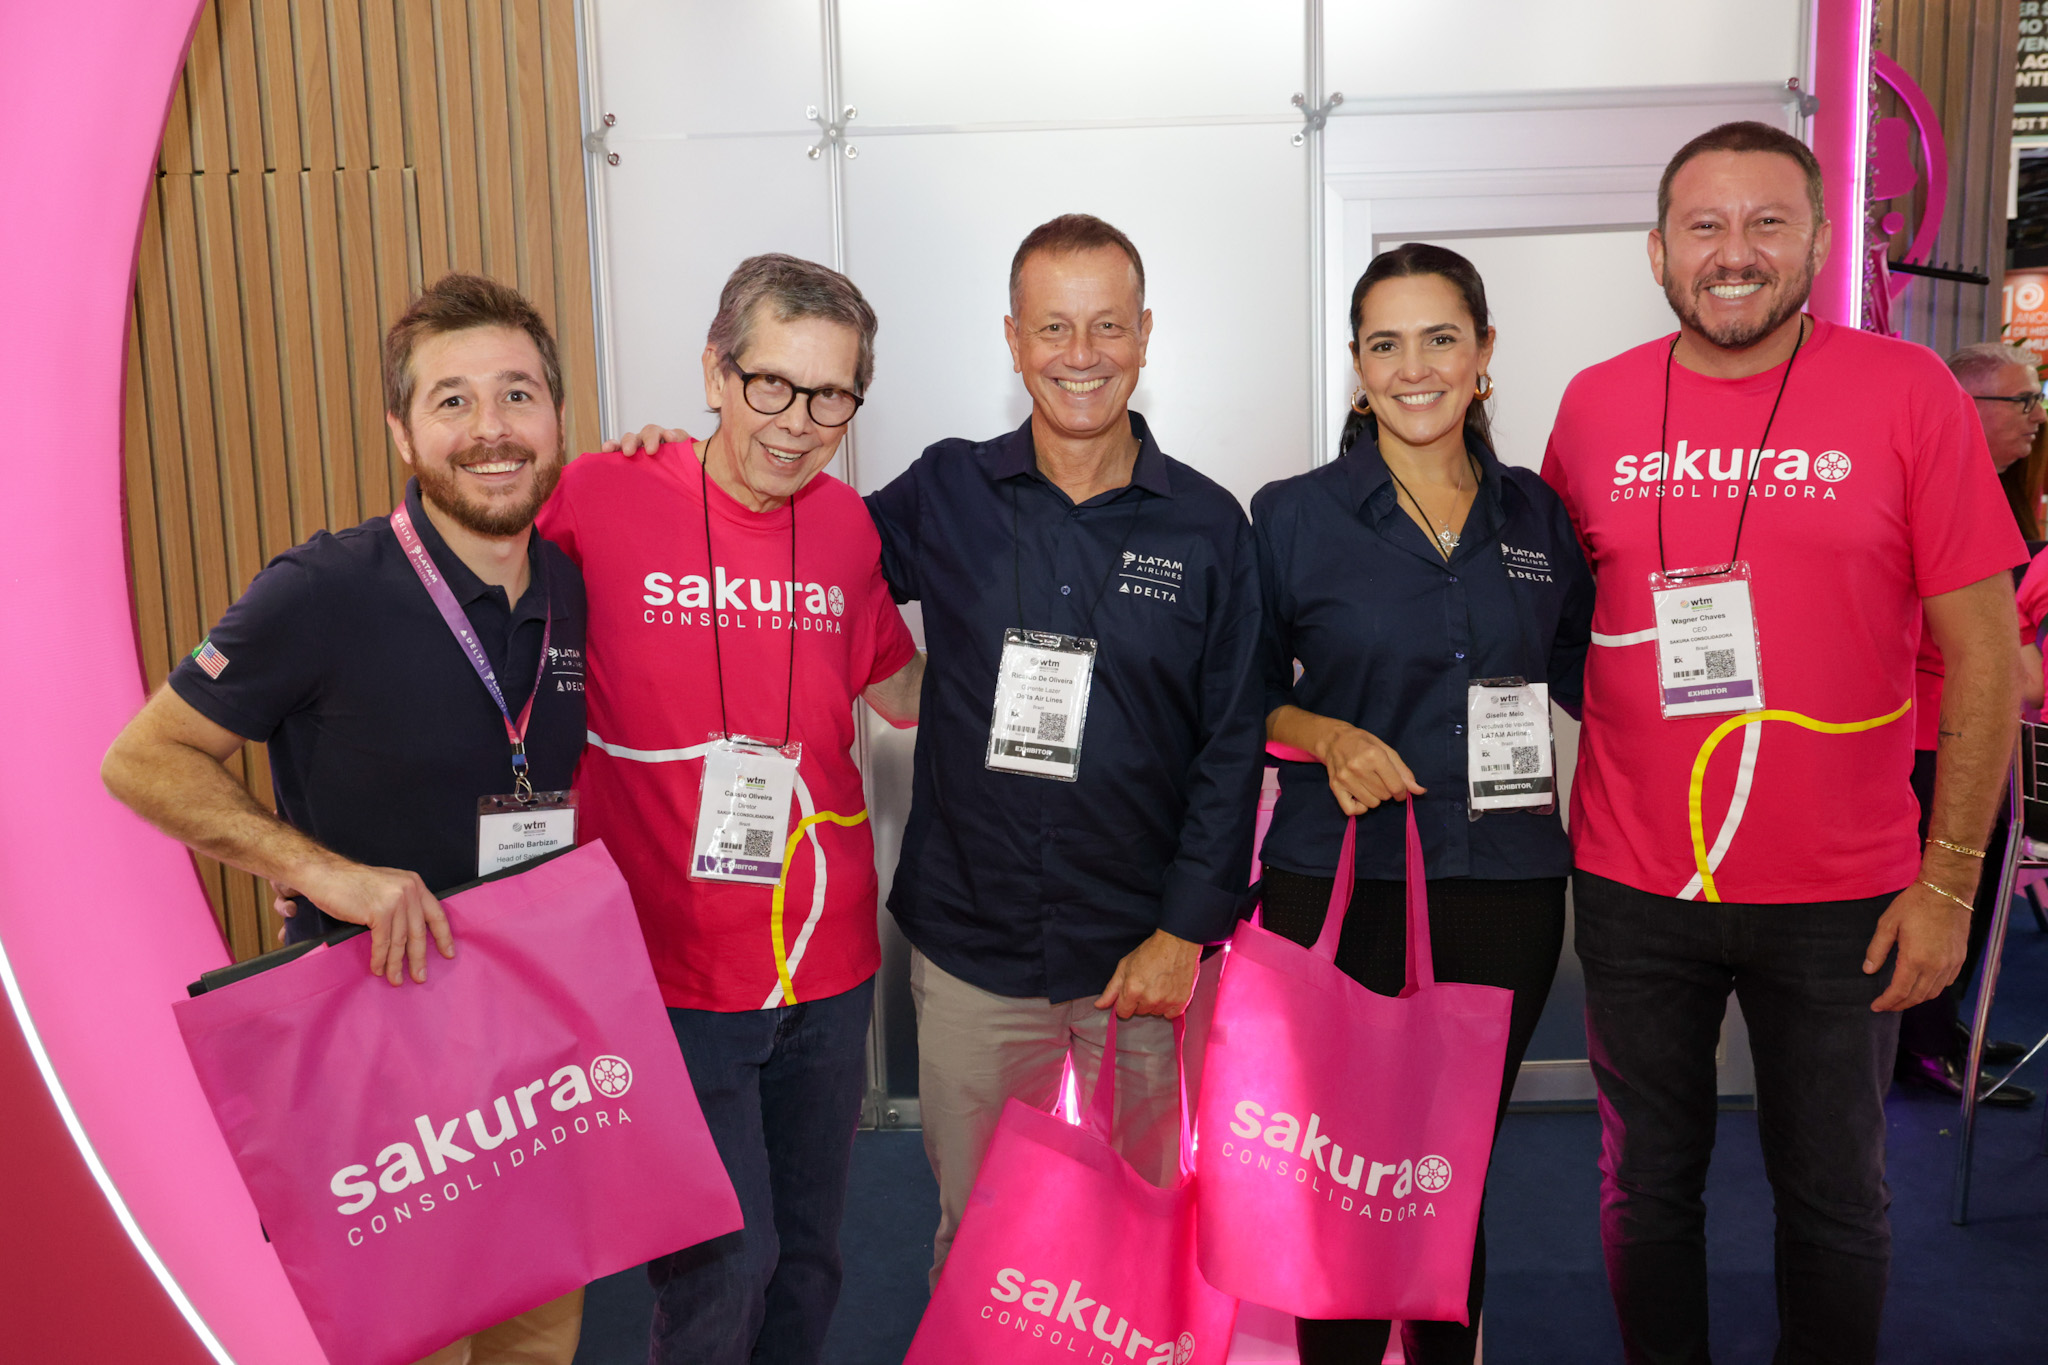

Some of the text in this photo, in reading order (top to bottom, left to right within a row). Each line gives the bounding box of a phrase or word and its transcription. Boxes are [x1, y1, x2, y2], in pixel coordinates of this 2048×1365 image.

[1612, 440, 1810, 486] sakura
[1610, 484, 1837, 502] CONSOLIDADORA
[397, 517, 438, 583] DELTA LATAM
[1510, 546, 1546, 560] LATAM
[1138, 554, 1183, 572] LATAM
[1136, 565, 1182, 580] AIRLINES
[1517, 571, 1553, 583] DELTA
[643, 566, 828, 615] sakura
[1133, 585, 1177, 603] DELTA
[1690, 598, 1712, 606] wtm
[643, 609, 842, 635] CONSOLIDADORA
[1671, 613, 1726, 625] Wagner Chaves
[466, 637, 485, 666] DELTA
[1040, 659, 1060, 668] wtm
[1500, 694, 1518, 702] wtm
[1688, 687, 1727, 697] EXHIBITOR
[1485, 711, 1507, 719] Giselle
[746, 776, 766, 785] wtm
[1494, 782, 1532, 791] EXHIBITOR
[748, 793, 773, 801] Oliveira
[523, 821, 546, 830] wtm
[498, 839, 558, 851] Danillo Barbizan
[497, 854, 514, 863] Head
[330, 1064, 593, 1216] sakura
[1229, 1100, 1413, 1200] sakura
[347, 1108, 632, 1247] CONSOLIDADORA
[1222, 1142, 1436, 1223] CONSOLIDADORA
[981, 1305, 1126, 1365] CONSOLID
